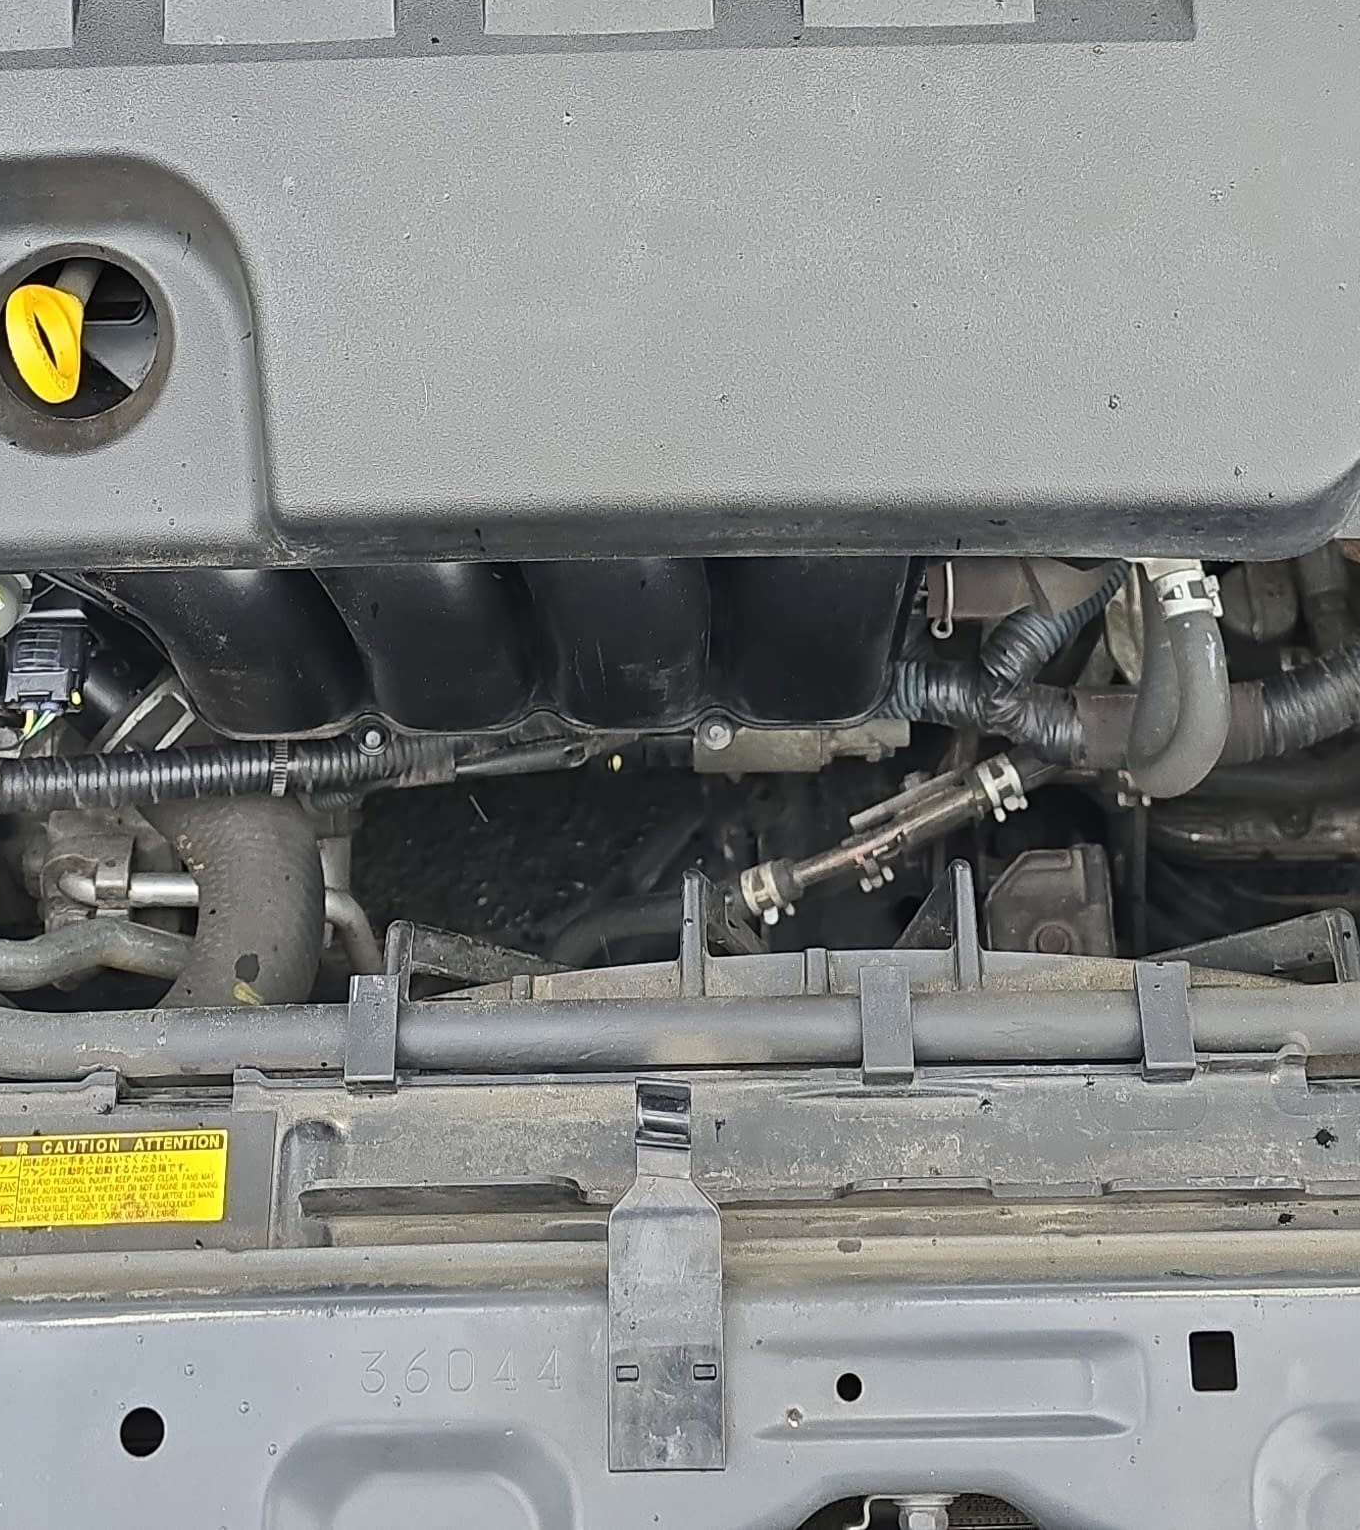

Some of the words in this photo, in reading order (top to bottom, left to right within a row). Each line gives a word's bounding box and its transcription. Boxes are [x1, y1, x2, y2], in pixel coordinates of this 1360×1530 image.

[42, 1138, 120, 1154] CAUTION
[133, 1134, 219, 1151] ATTENTION
[53, 1178, 85, 1186] PERSONAL
[115, 1175, 131, 1183] KEEP
[134, 1174, 154, 1182] HANDS
[182, 1173, 198, 1181] FANS
[0, 1181, 16, 1192] FANS
[41, 1186, 91, 1194] AUTOMATICALLY
[95, 1183, 125, 1192] WHETHER
[155, 1182, 178, 1190] ENGINE
[359, 1345, 564, 1395] 36044
